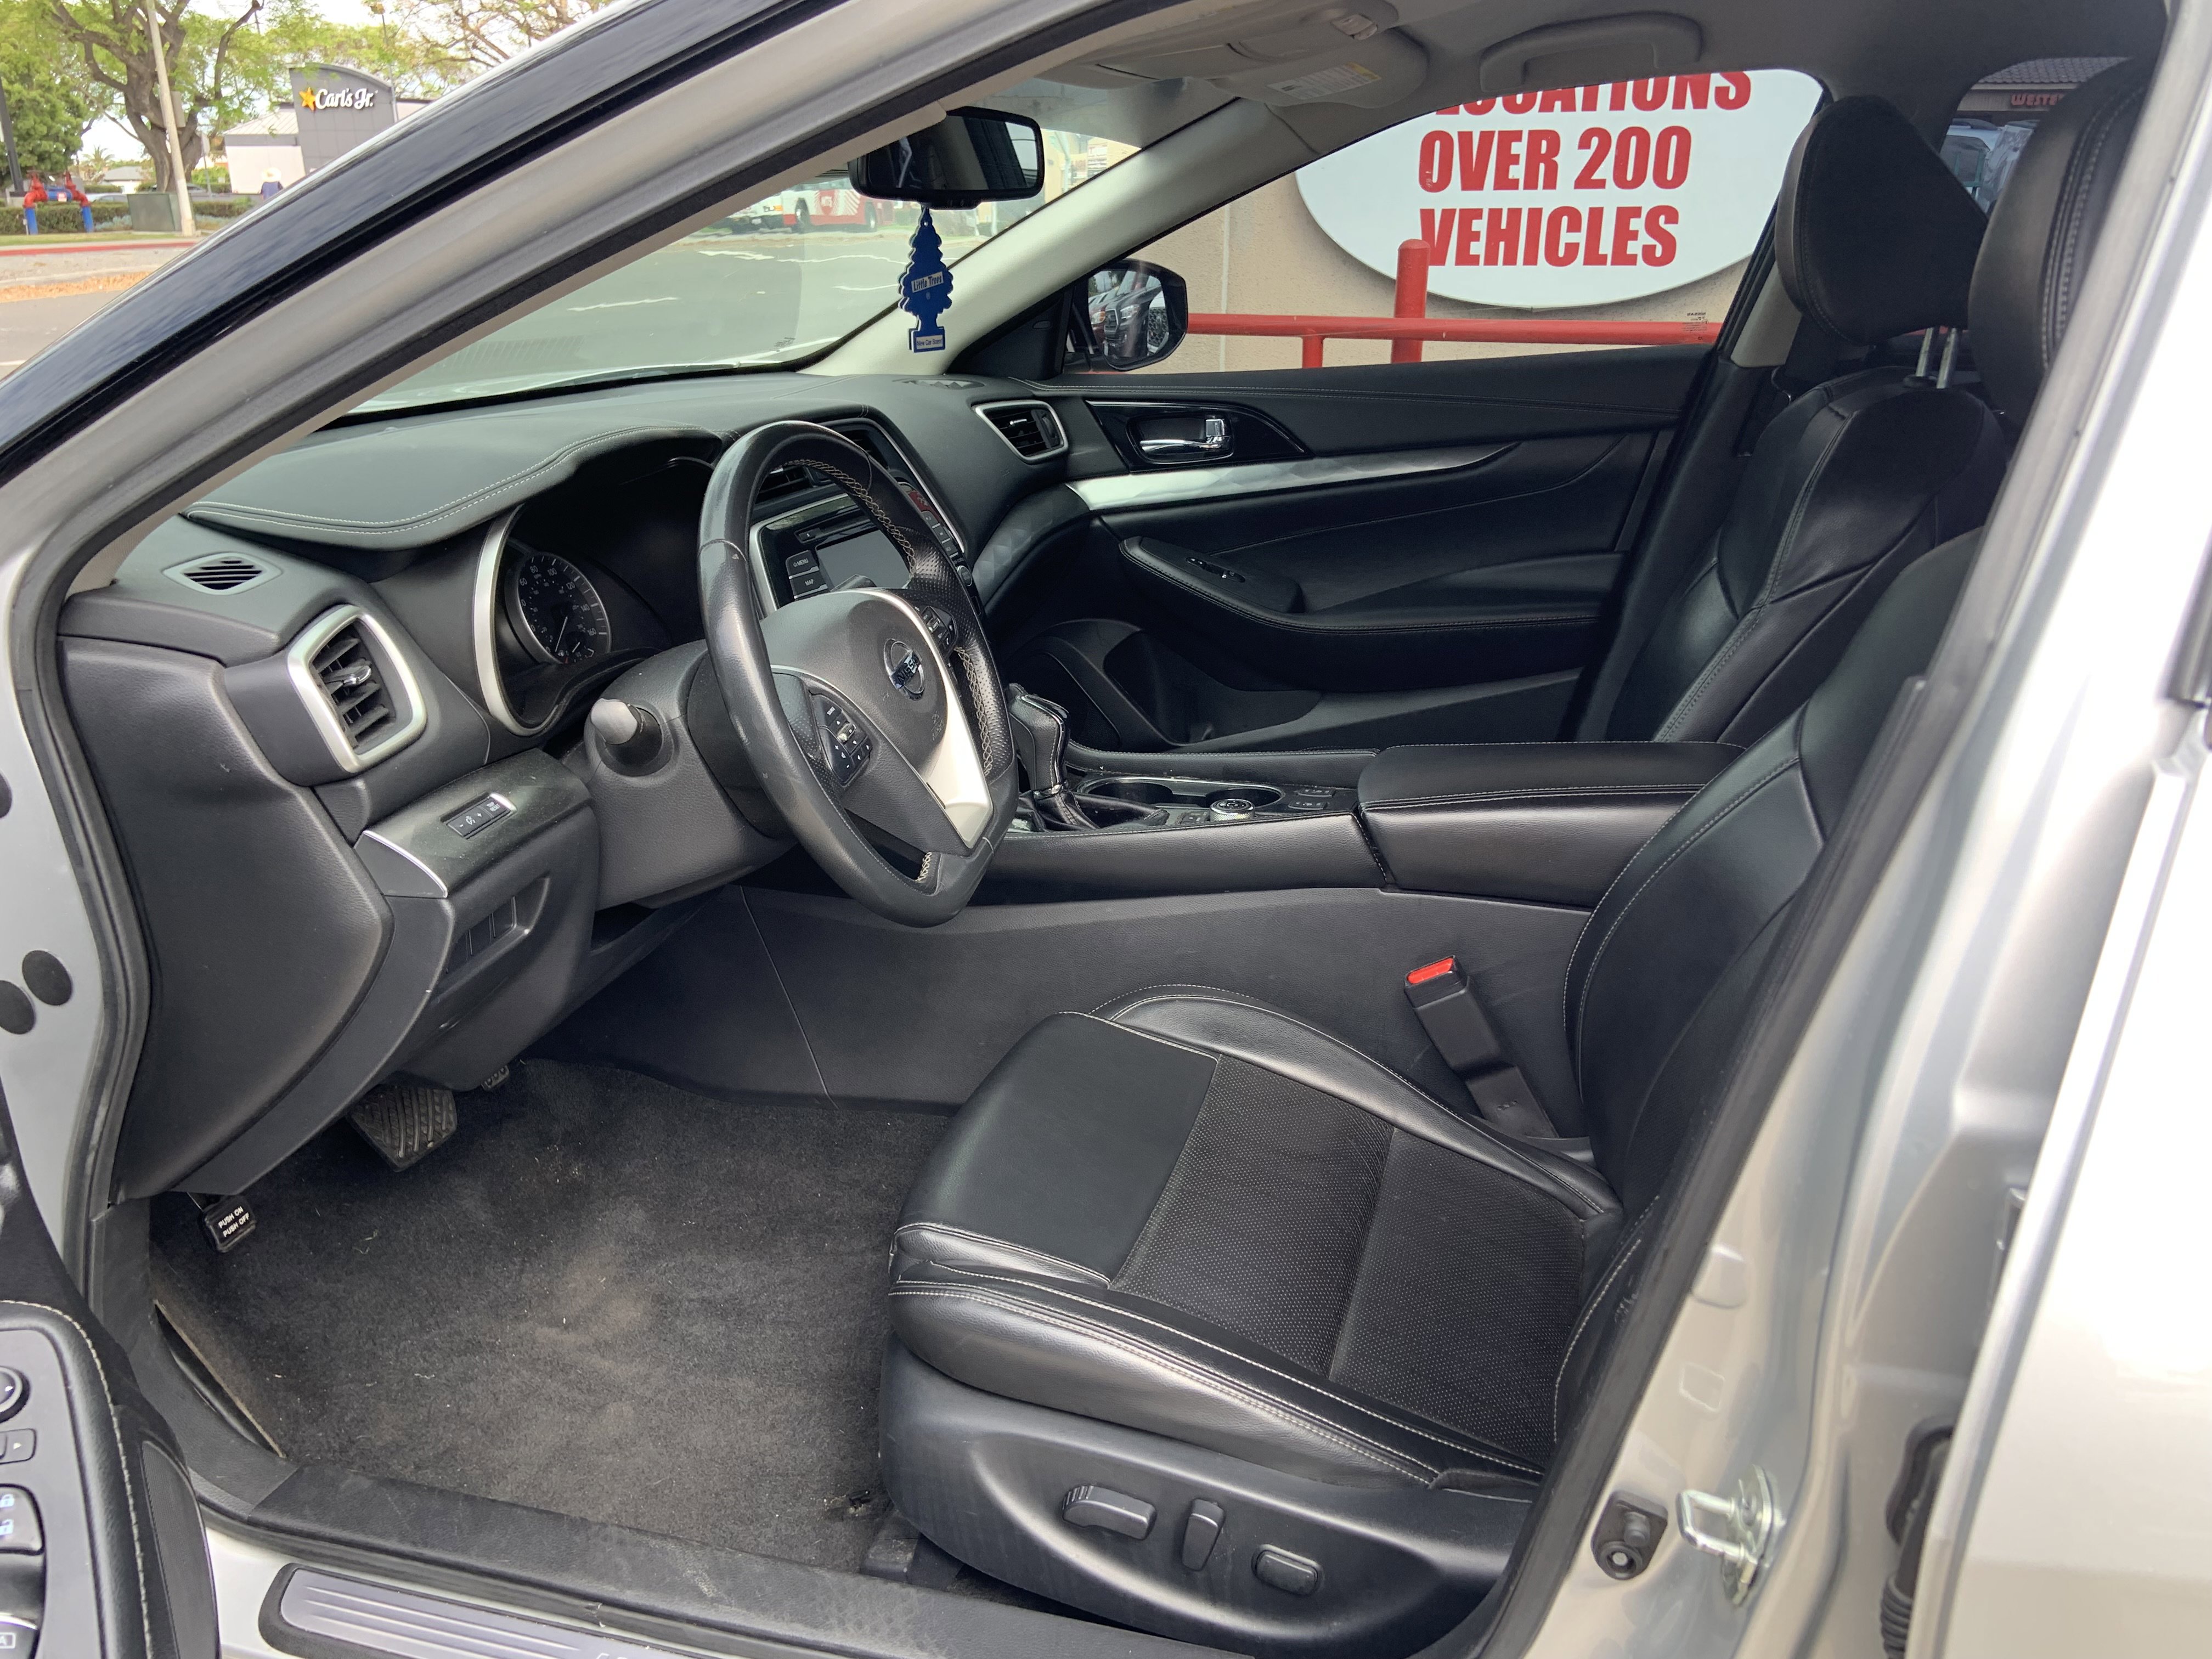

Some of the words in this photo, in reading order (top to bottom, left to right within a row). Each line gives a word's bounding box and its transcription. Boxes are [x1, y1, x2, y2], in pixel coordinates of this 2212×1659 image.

[315, 88, 353, 109] Carl's
[354, 88, 374, 110] Jr.
[2011, 93, 2064, 106] WESTE
[1418, 129, 1561, 193] OVER
[1573, 126, 1692, 190] 200
[1419, 205, 1679, 267] VEHICLES
[913, 278, 927, 291] Little
[928, 275, 942, 286] Trees
[797, 558, 809, 566] MENU
[218, 1213, 235, 1228] PUSH
[234, 1206, 244, 1216] ON
[223, 1222, 239, 1238] PUSH
[239, 1212, 249, 1225] OFF
